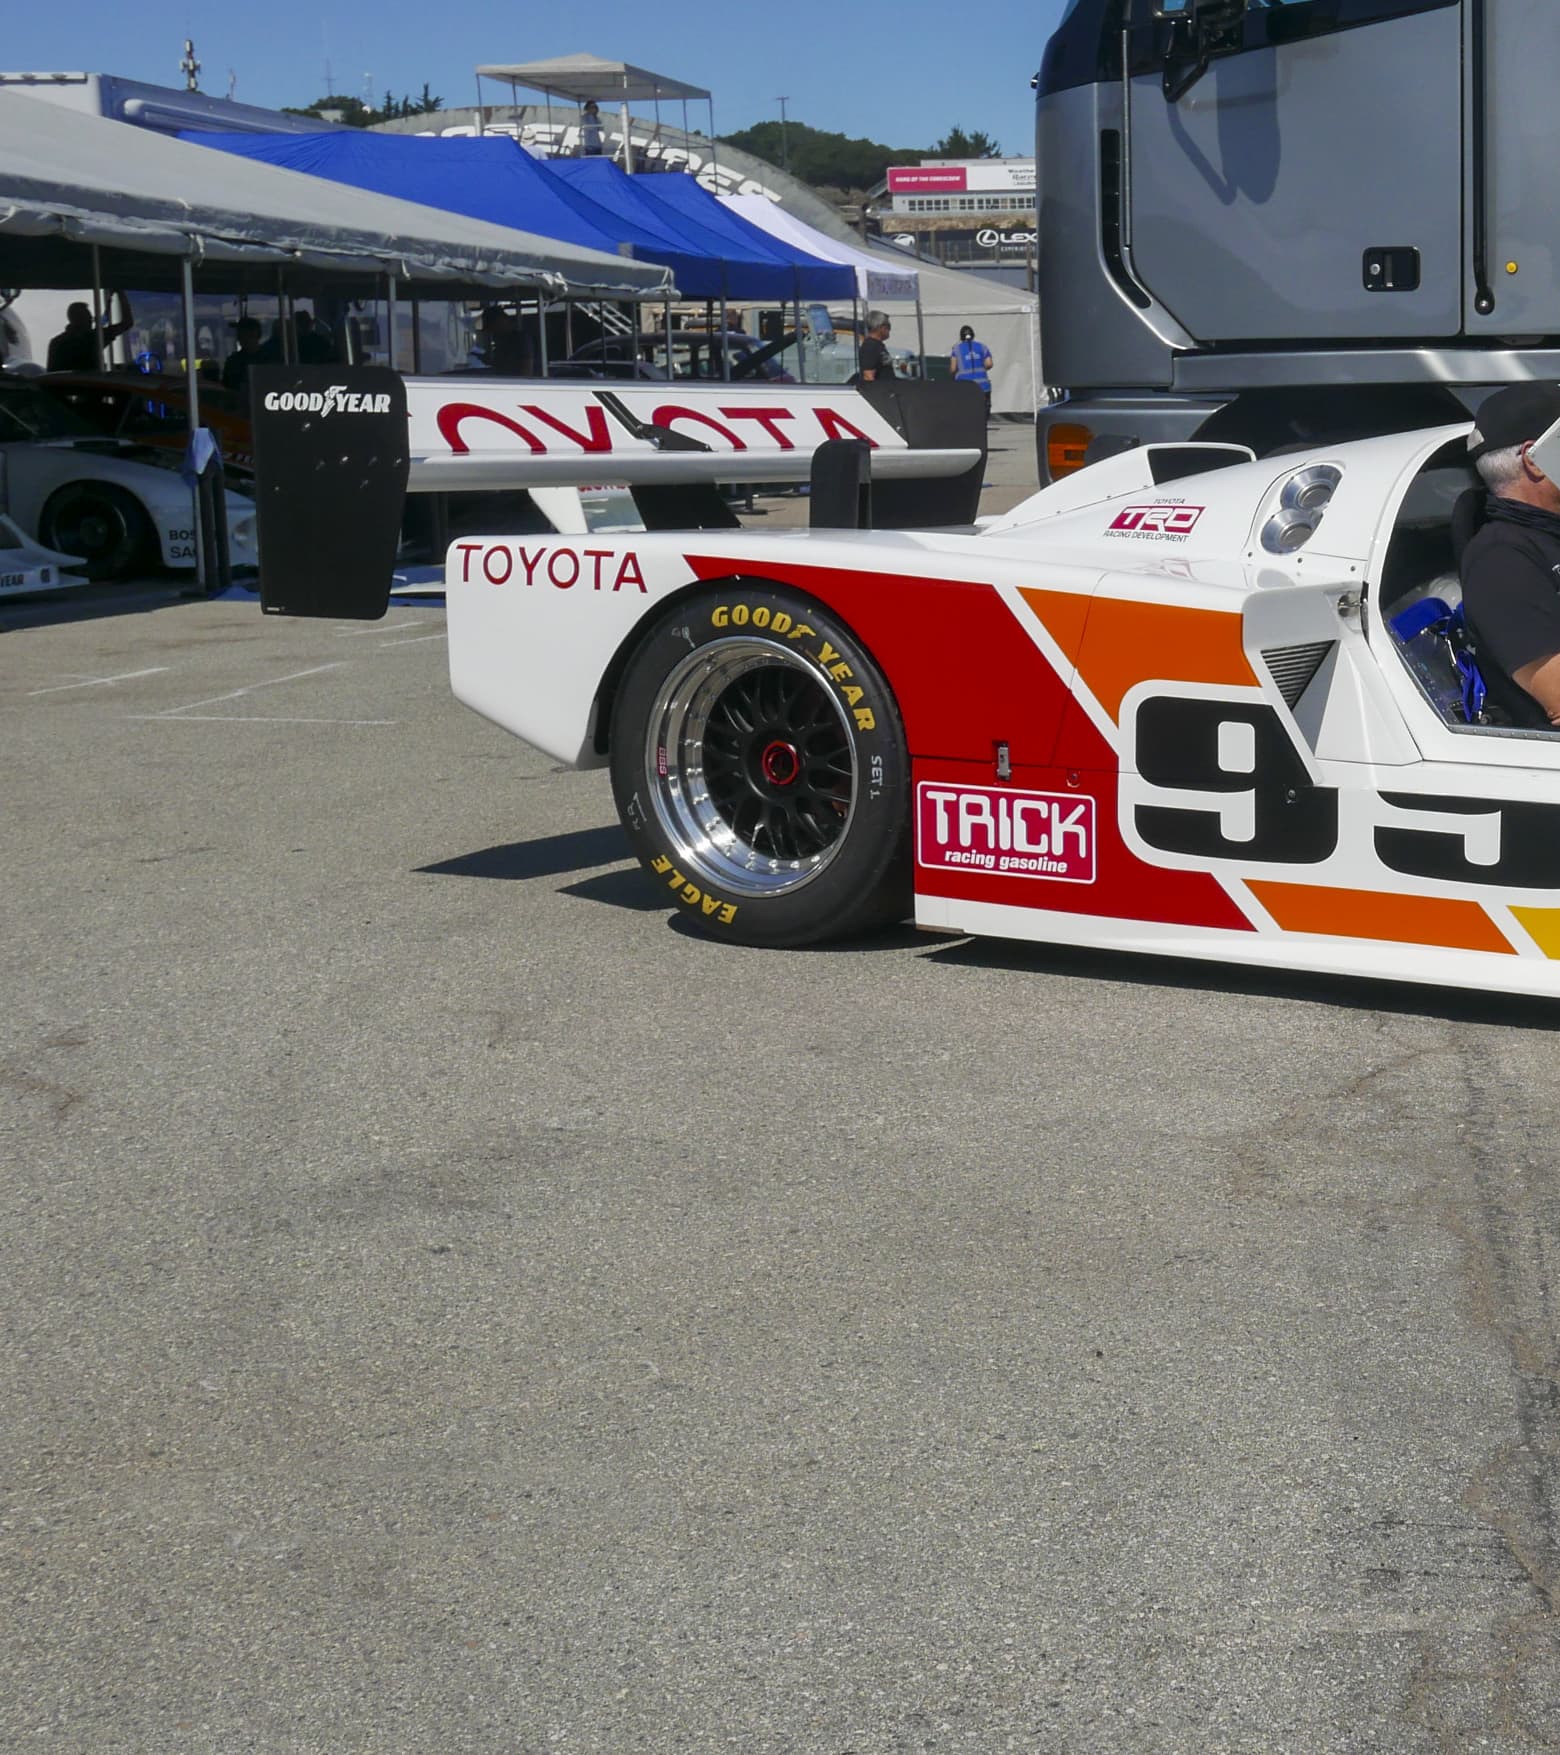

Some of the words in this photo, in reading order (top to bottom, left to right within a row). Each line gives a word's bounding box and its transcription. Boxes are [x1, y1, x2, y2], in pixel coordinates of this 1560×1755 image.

[1118, 507, 1202, 531] TRD
[1103, 530, 1131, 538] RACING
[1132, 532, 1189, 543] DEVELOPMENT
[456, 544, 648, 593] TOYOTA
[871, 755, 883, 786] SET
[926, 790, 1087, 859] TRICK
[944, 849, 995, 868] racing
[999, 856, 1068, 873] gasoline
[651, 854, 738, 924] EAGLE
